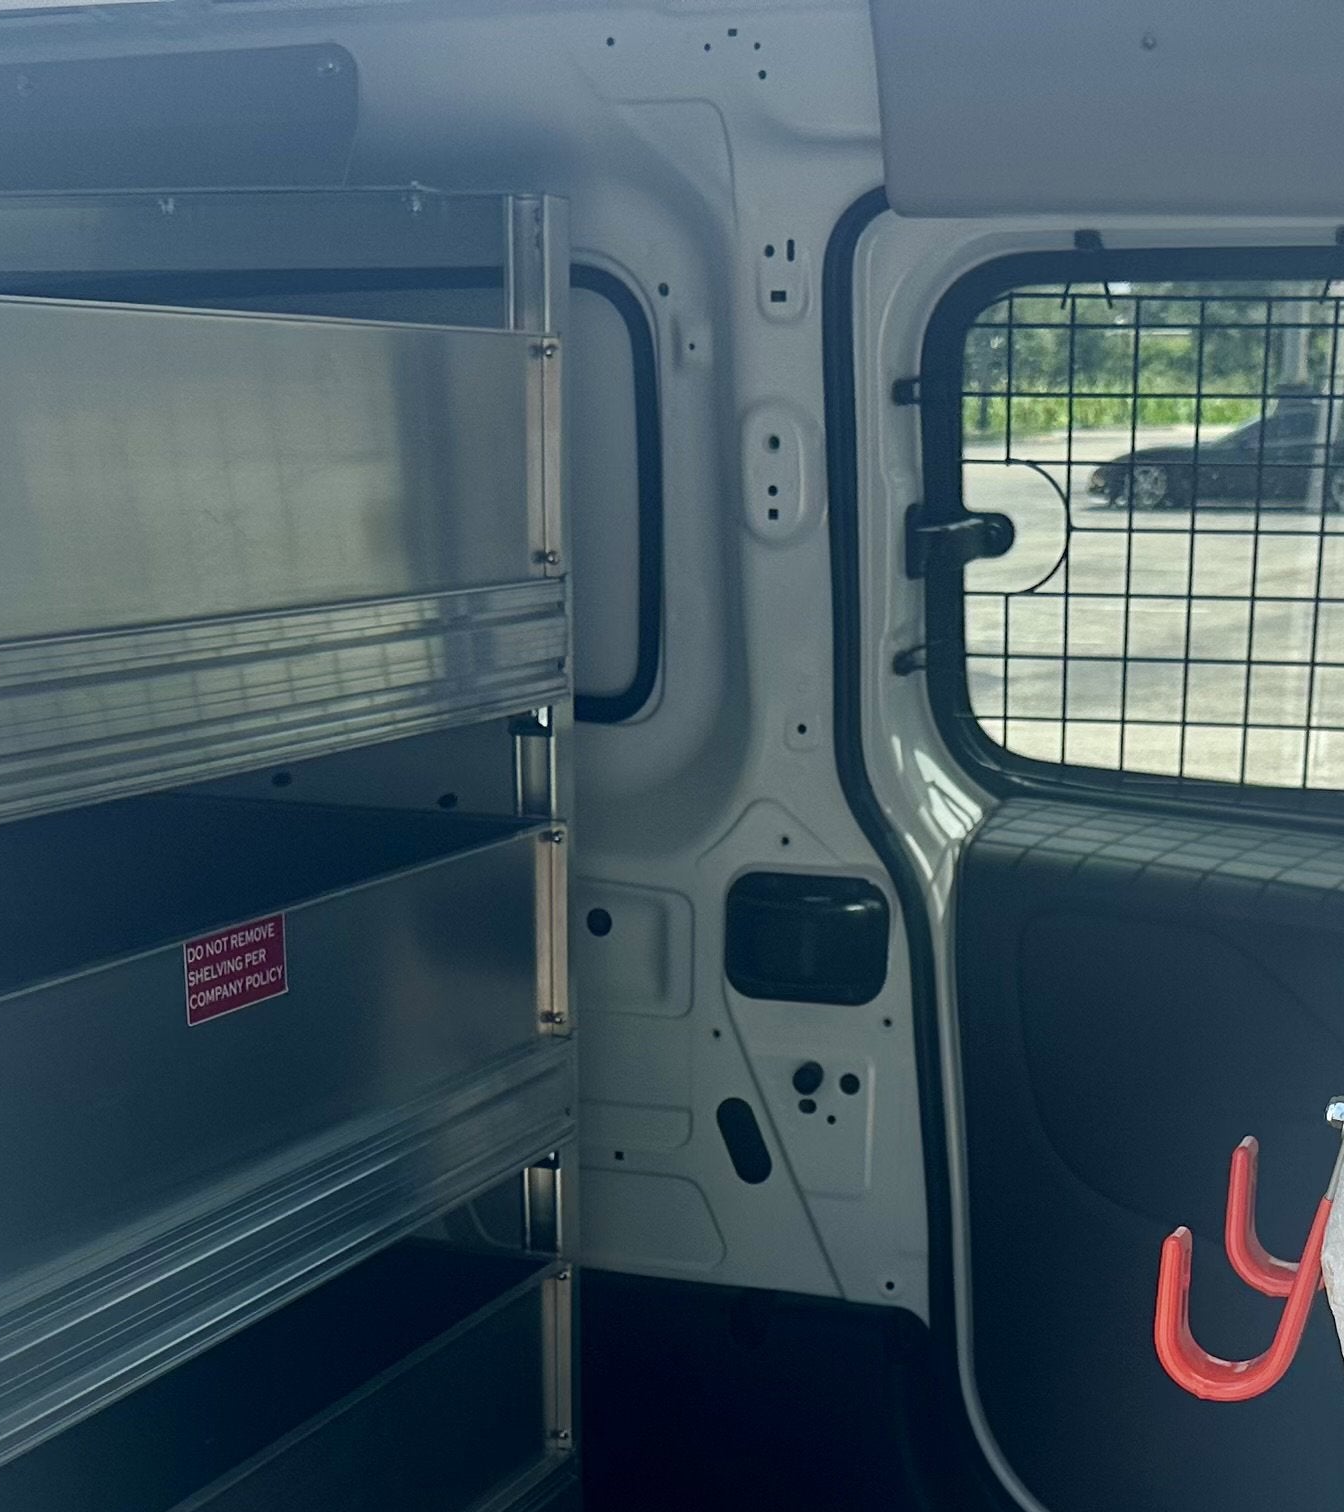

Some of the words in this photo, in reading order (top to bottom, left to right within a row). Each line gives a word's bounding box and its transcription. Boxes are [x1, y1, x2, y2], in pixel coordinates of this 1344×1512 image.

[187, 945, 204, 963] DO
[206, 937, 229, 958] NOT
[230, 923, 275, 949] REMOVE
[188, 956, 243, 987] SHELVING
[244, 948, 266, 968] PER
[189, 978, 244, 1010] COMPANY
[245, 965, 283, 991] POLICY
